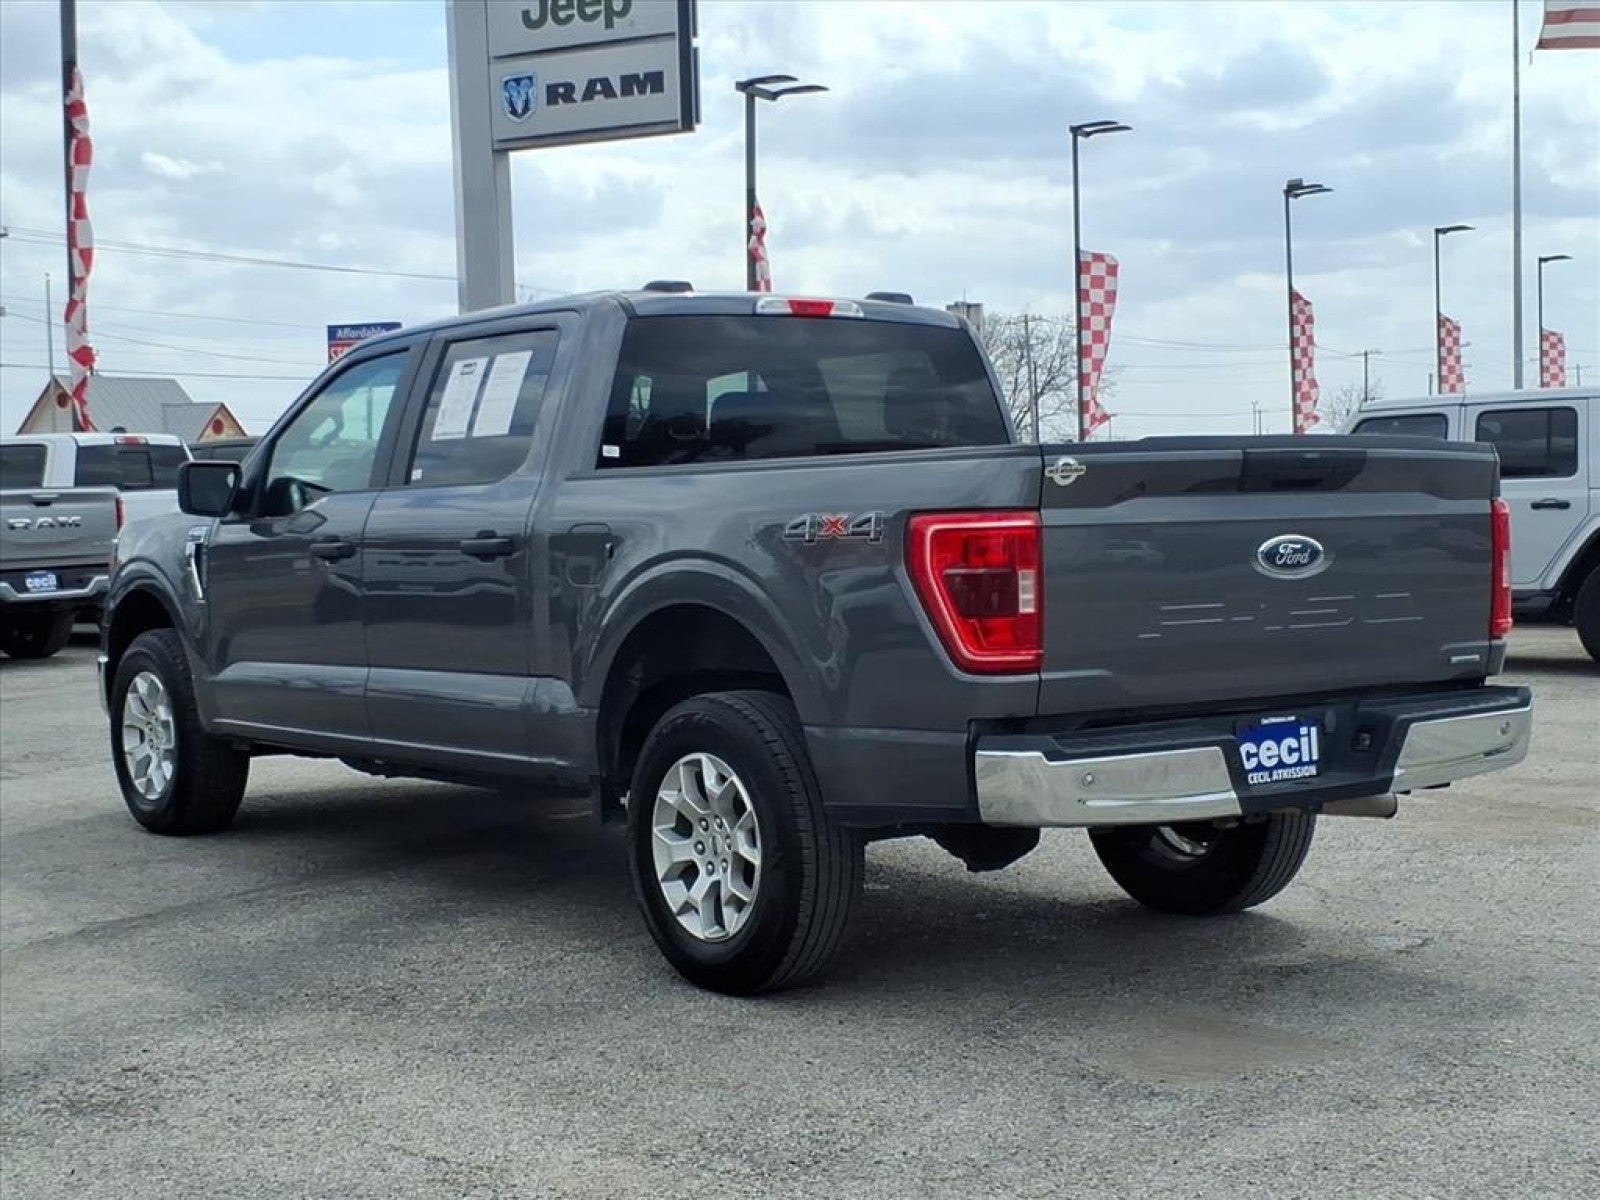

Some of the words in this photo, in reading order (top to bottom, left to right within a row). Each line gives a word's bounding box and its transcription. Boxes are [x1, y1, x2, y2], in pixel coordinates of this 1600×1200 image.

[521, 0, 633, 30] Jeep
[545, 70, 665, 107] RAM
[8, 515, 82, 531] RAM
[1275, 543, 1311, 565] Ford
[1239, 727, 1319, 770] cecil
[1248, 771, 1271, 785] CECIL
